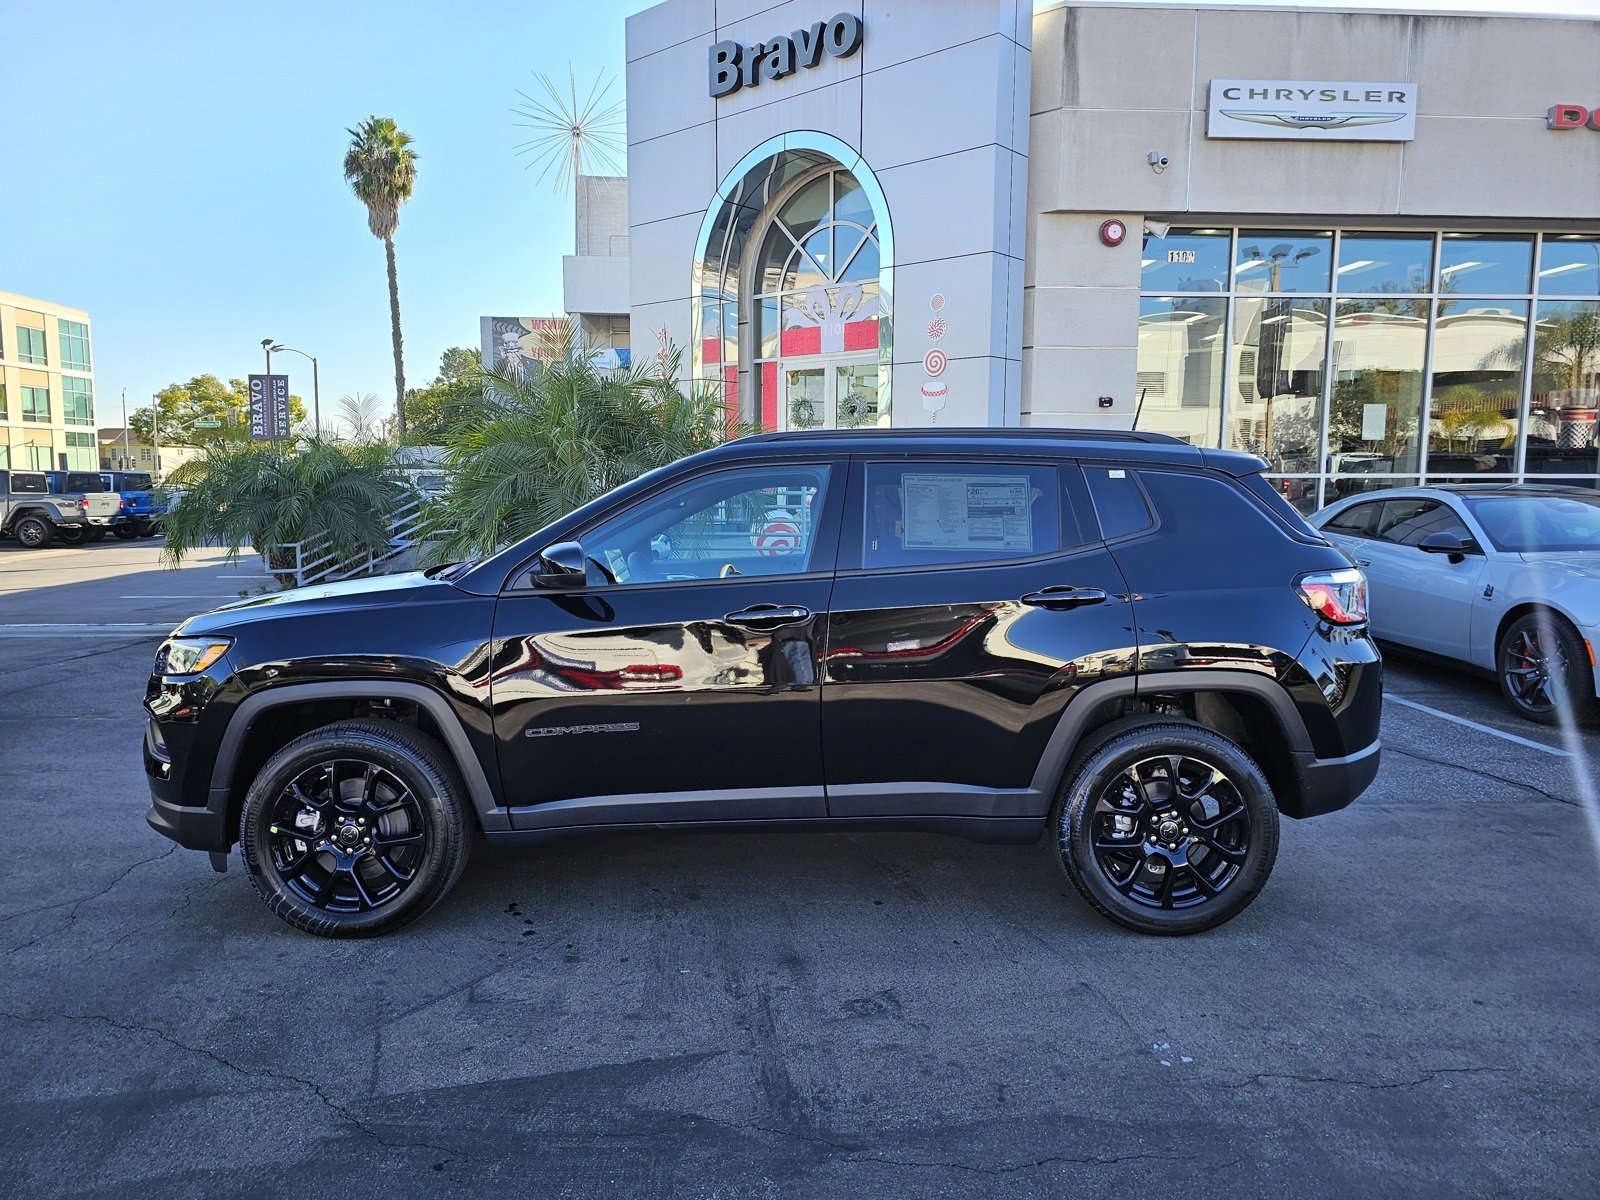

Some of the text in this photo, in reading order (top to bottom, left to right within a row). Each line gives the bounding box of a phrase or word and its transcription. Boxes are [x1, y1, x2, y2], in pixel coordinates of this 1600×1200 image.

[709, 12, 863, 98] Bravo
[1222, 87, 1406, 103] CHRYSLER
[1547, 104, 1600, 130] D
[251, 379, 263, 436] BRAVO
[277, 379, 287, 436] SERVICE
[524, 721, 640, 738] COMPASS
